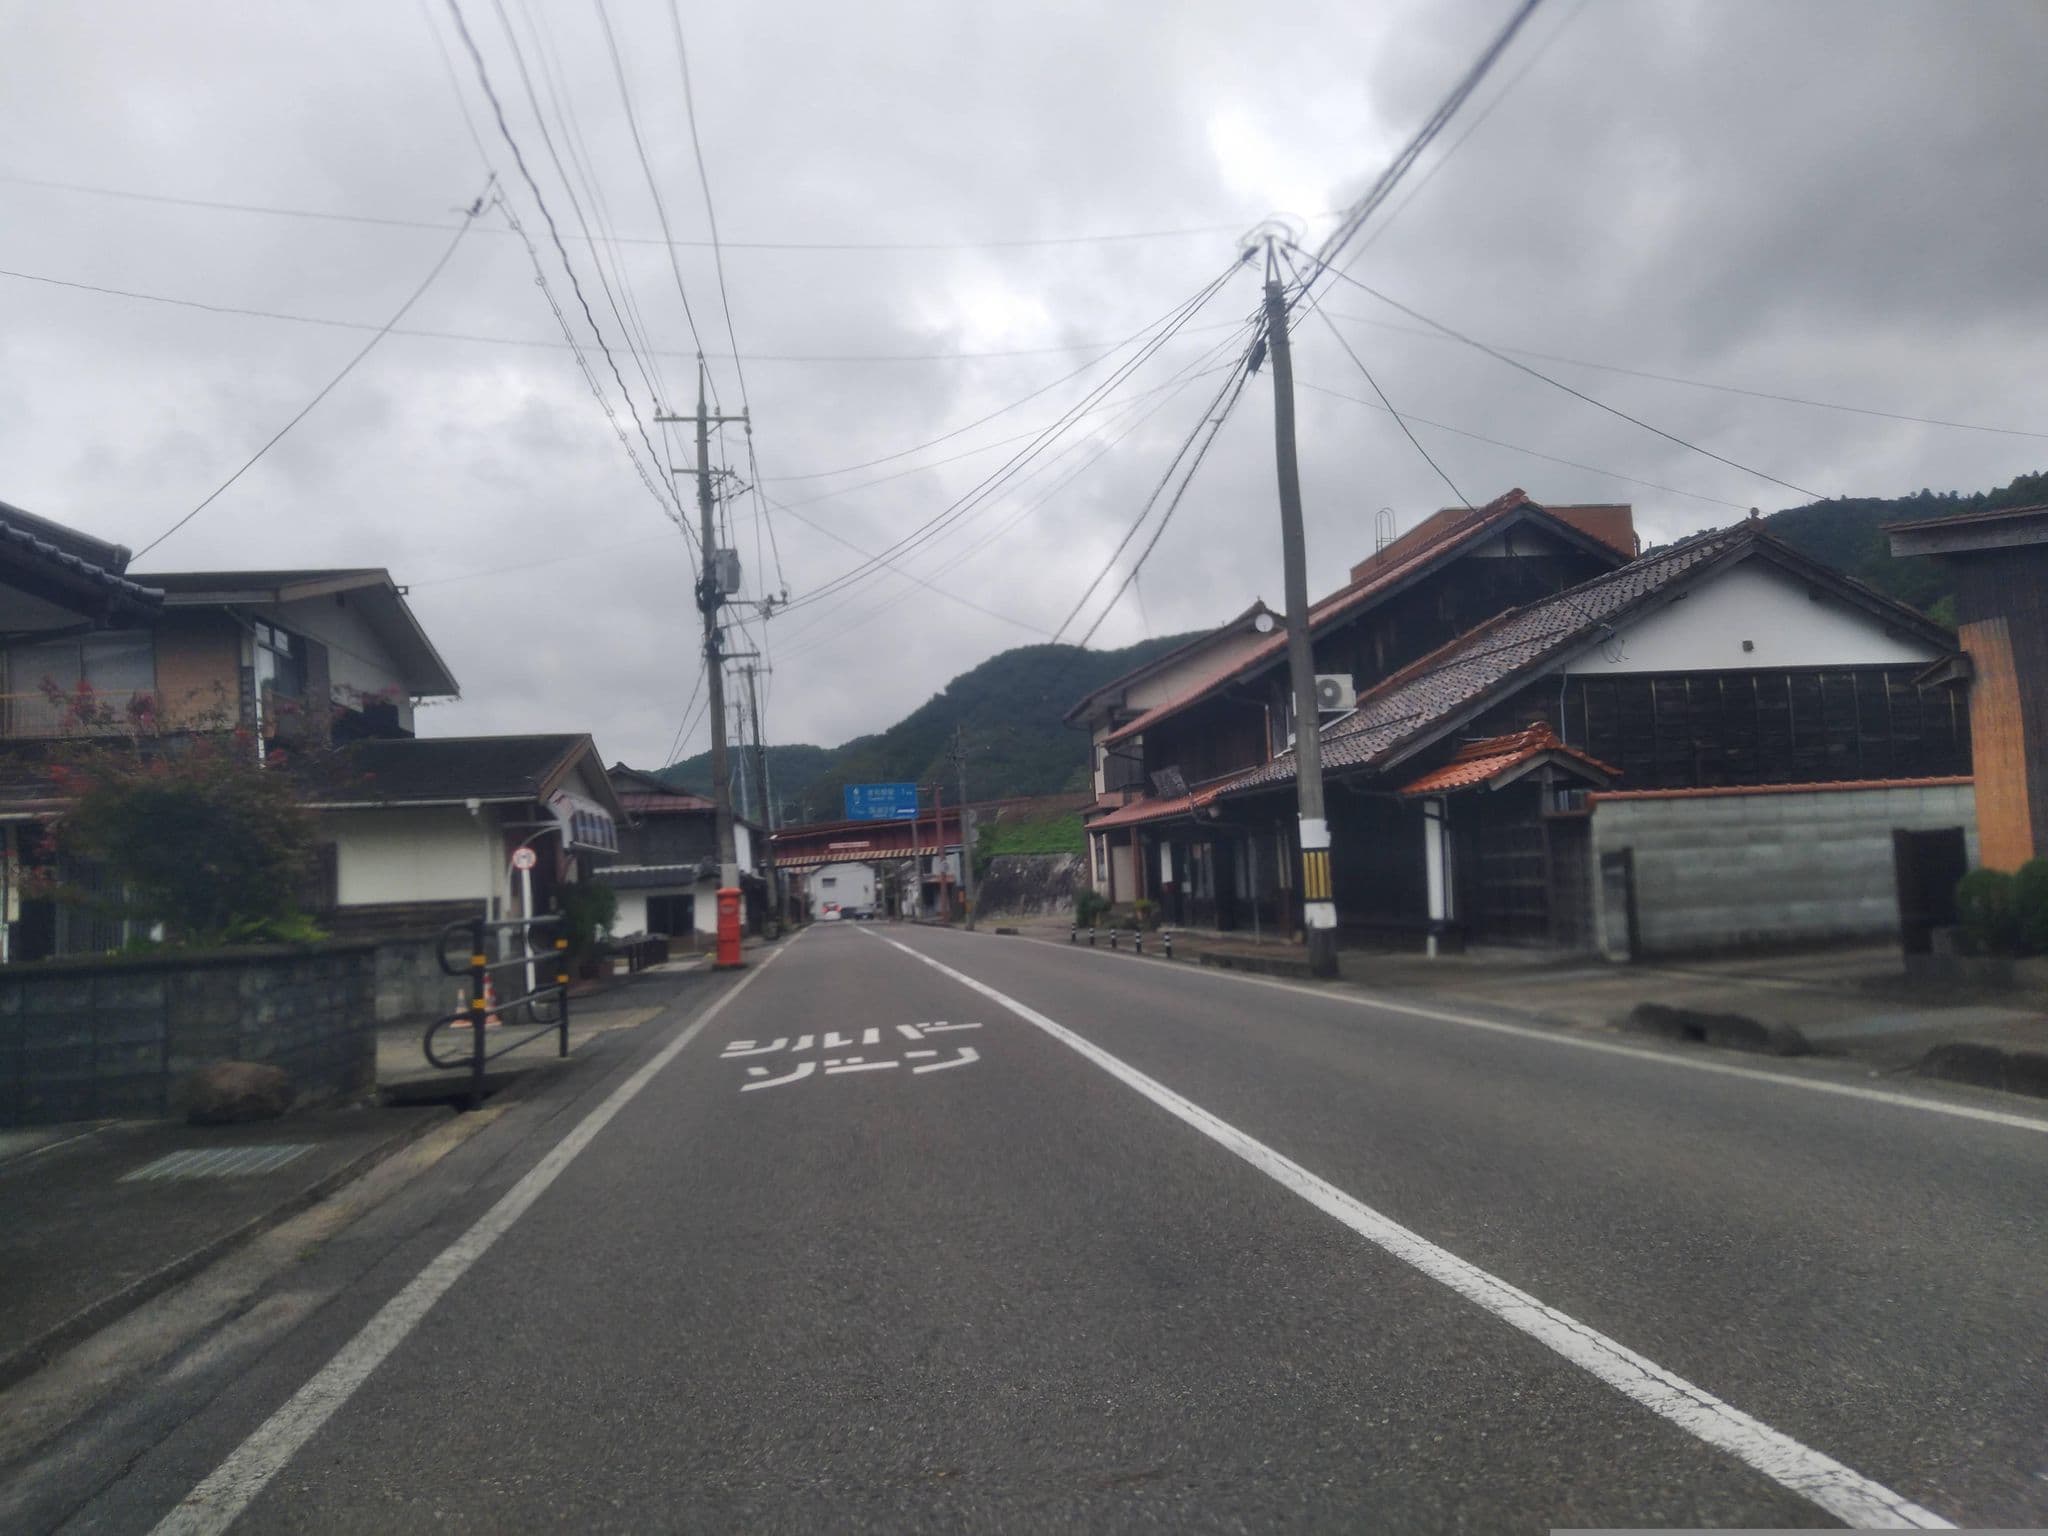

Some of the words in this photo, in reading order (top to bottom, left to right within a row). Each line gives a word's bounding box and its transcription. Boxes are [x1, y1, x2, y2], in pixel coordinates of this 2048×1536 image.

[720, 1022, 983, 1058] シルバー
[741, 1047, 980, 1092] ゾーン
